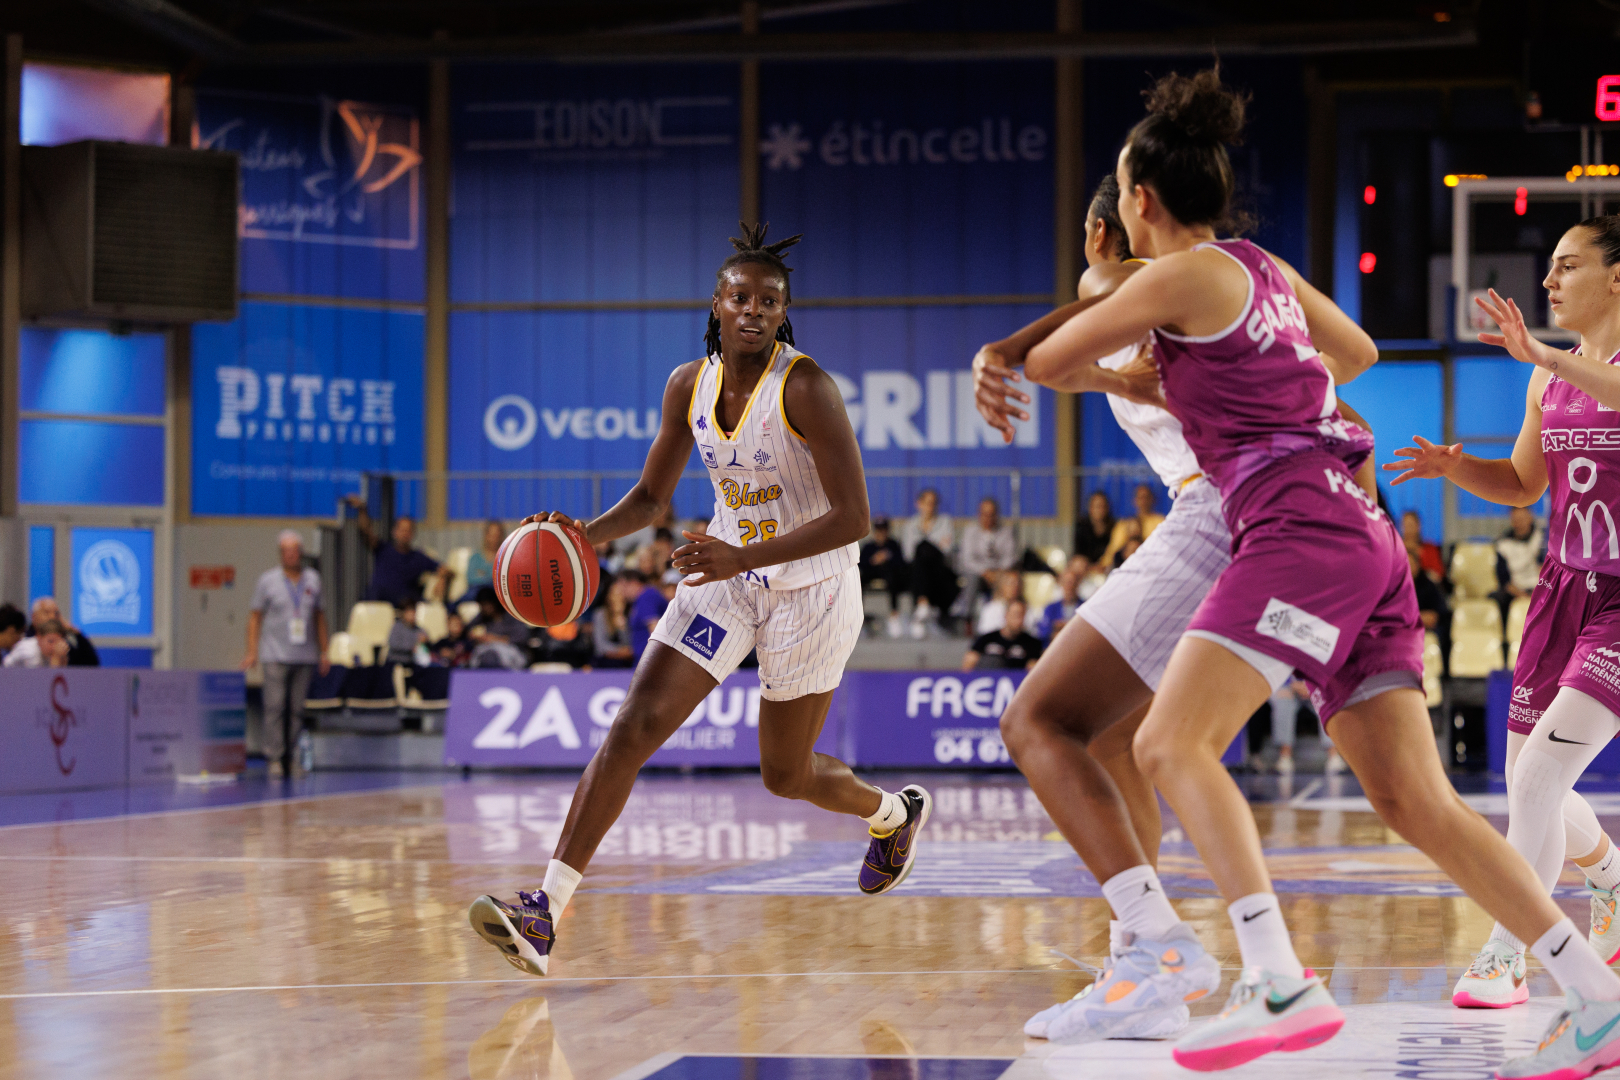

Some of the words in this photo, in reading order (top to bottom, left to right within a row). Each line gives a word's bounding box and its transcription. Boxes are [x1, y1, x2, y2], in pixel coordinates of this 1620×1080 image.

[535, 98, 662, 148] EDISON
[819, 117, 1049, 167] étincelle
[216, 365, 396, 440] PITCH
[541, 407, 661, 440] VEOLI
[719, 478, 783, 510] Blma
[520, 574, 533, 598] FIBA
[549, 559, 564, 606] molten
[685, 635, 713, 657] COGEDIM
[473, 687, 581, 749] 2A
[1509, 703, 1545, 718] RÉNÉES
[1509, 711, 1541, 724] SCOGN
[934, 735, 974, 764] 04
